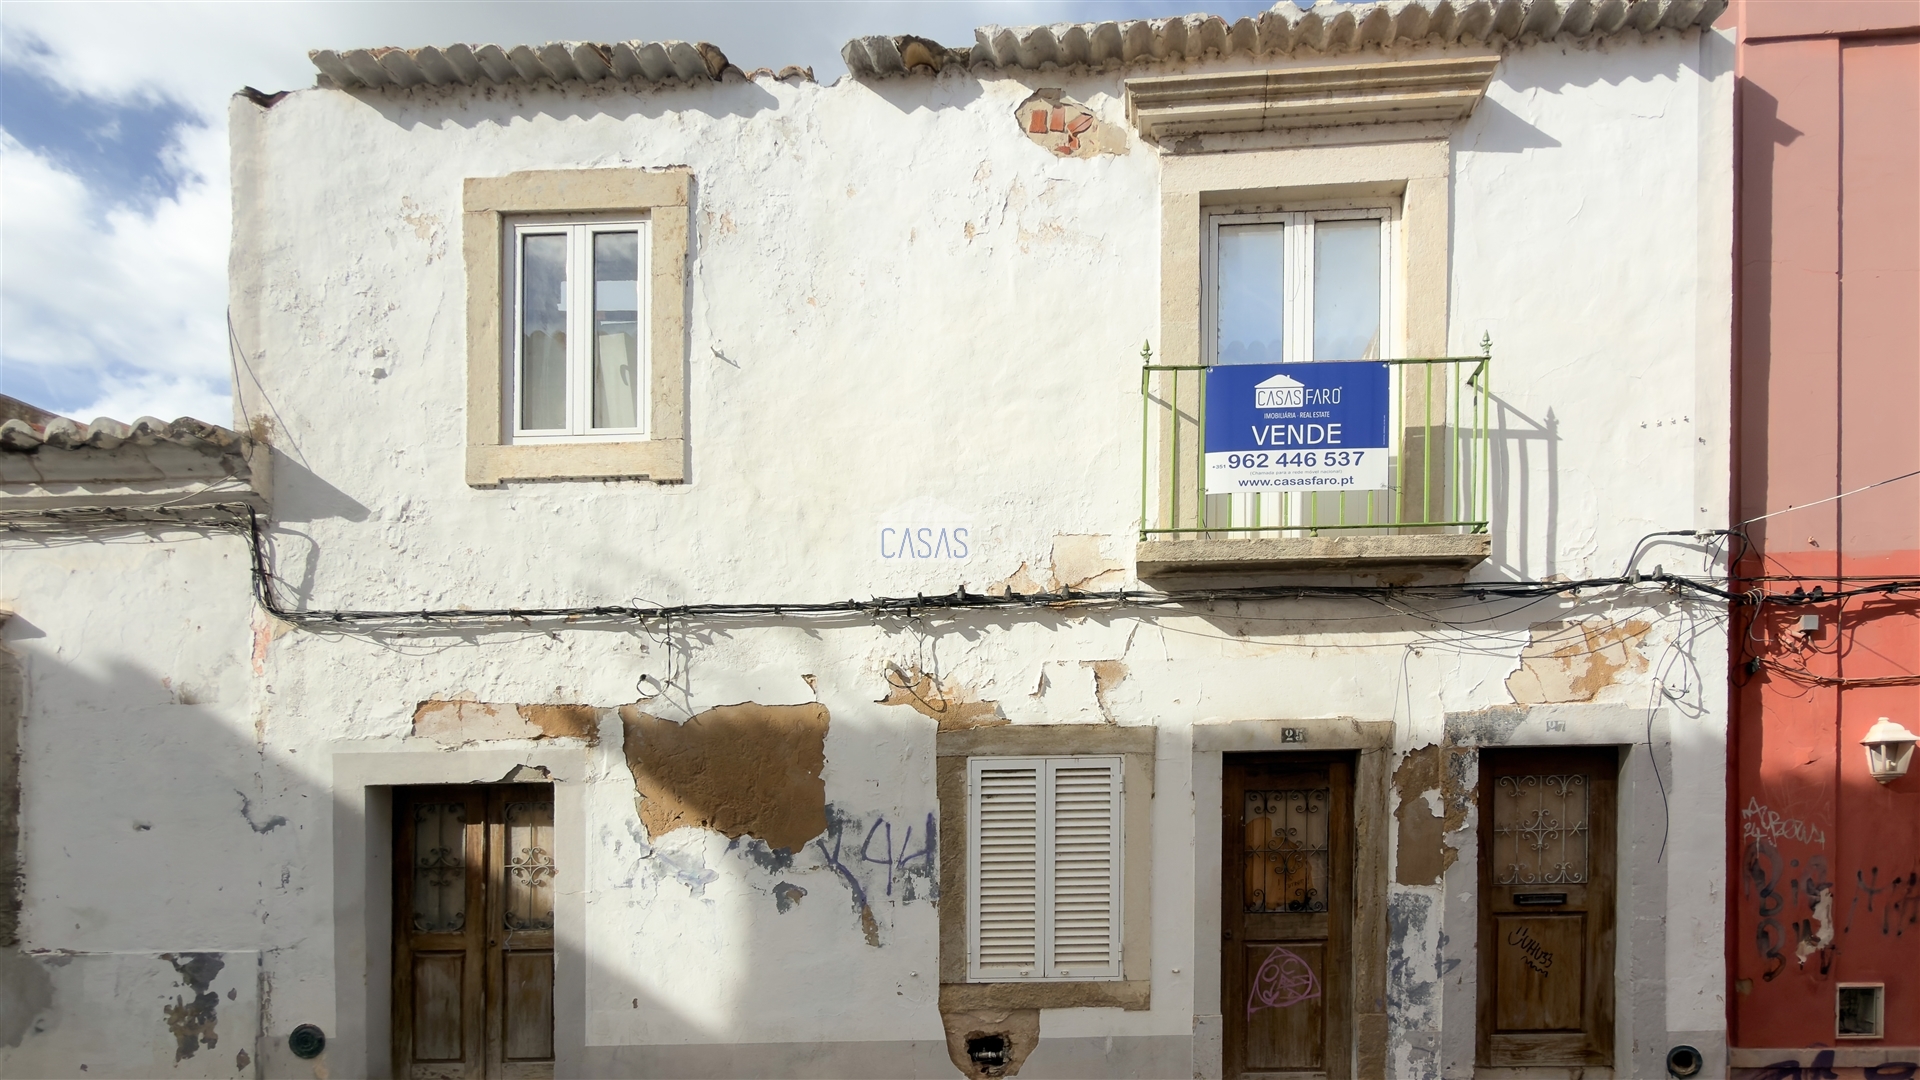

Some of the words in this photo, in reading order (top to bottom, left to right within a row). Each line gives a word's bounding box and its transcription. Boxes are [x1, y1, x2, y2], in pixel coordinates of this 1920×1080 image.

[1257, 389, 1302, 407] CASAS
[1305, 387, 1341, 405] FARO
[1263, 411, 1297, 419] IMOBILIÁRIA
[1299, 411, 1312, 419] REAL
[1251, 423, 1342, 446] VENDE
[1228, 453, 1269, 469] 962
[1275, 452, 1317, 468] 446
[1323, 451, 1365, 467] 537
[1238, 475, 1355, 487] www.casasfaro.pt
